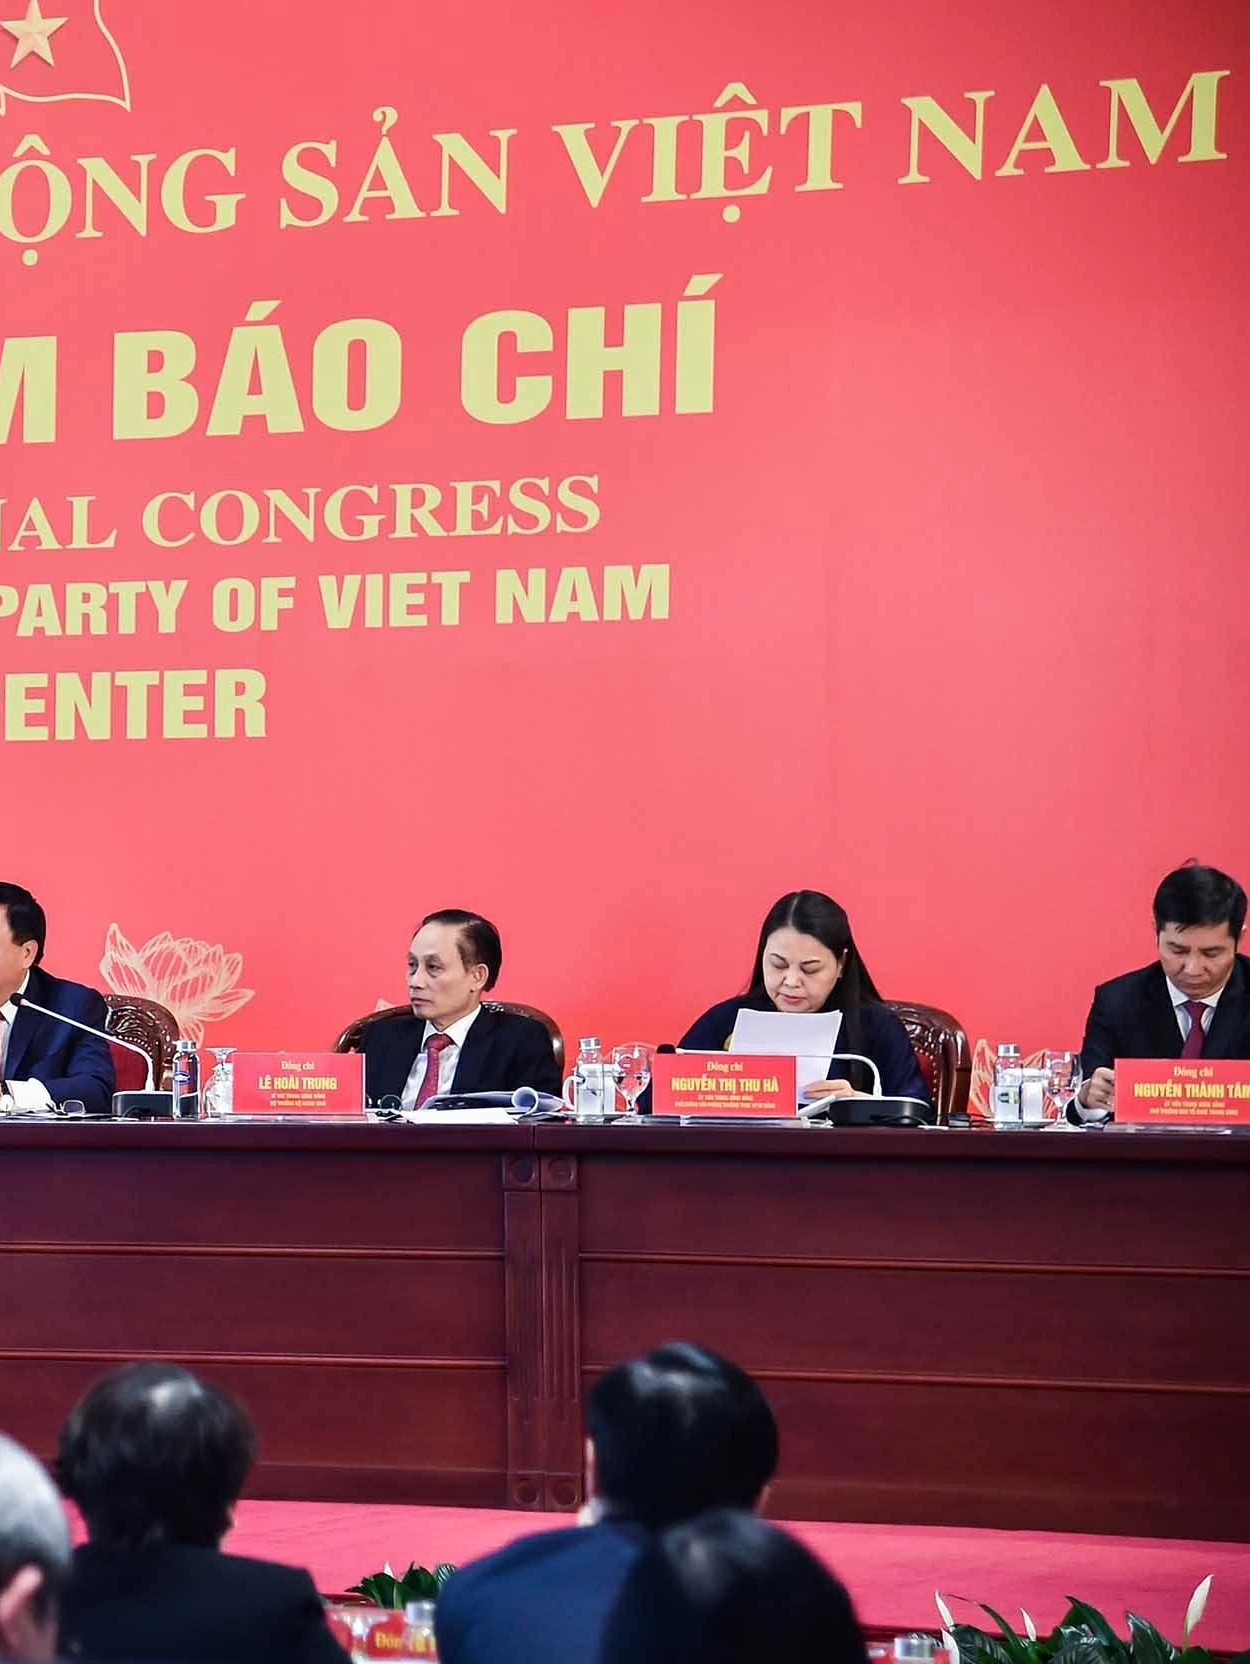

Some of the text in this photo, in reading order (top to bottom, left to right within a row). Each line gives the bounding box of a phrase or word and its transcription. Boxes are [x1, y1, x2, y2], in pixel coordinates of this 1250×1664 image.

[280, 107, 516, 228] SẢN
[552, 83, 862, 222] VIỆT
[899, 72, 1229, 184] NAM
[113, 300, 401, 440] BÁO
[461, 274, 722, 424] CHÍ
[143, 475, 600, 547] CONGRESS
[213, 577, 296, 632] OF
[319, 571, 470, 628] VIET
[496, 564, 670, 624] NAM
[258, 1073, 338, 1090] LÊ HOÀI TRUNG
[718, 1077, 736, 1094] THỊ
[739, 1078, 760, 1092] THU
[763, 1076, 779, 1093] HÀ
[1133, 1079, 1182, 1098] NGUYỄN
[1184, 1081, 1225, 1099] THÀNH
